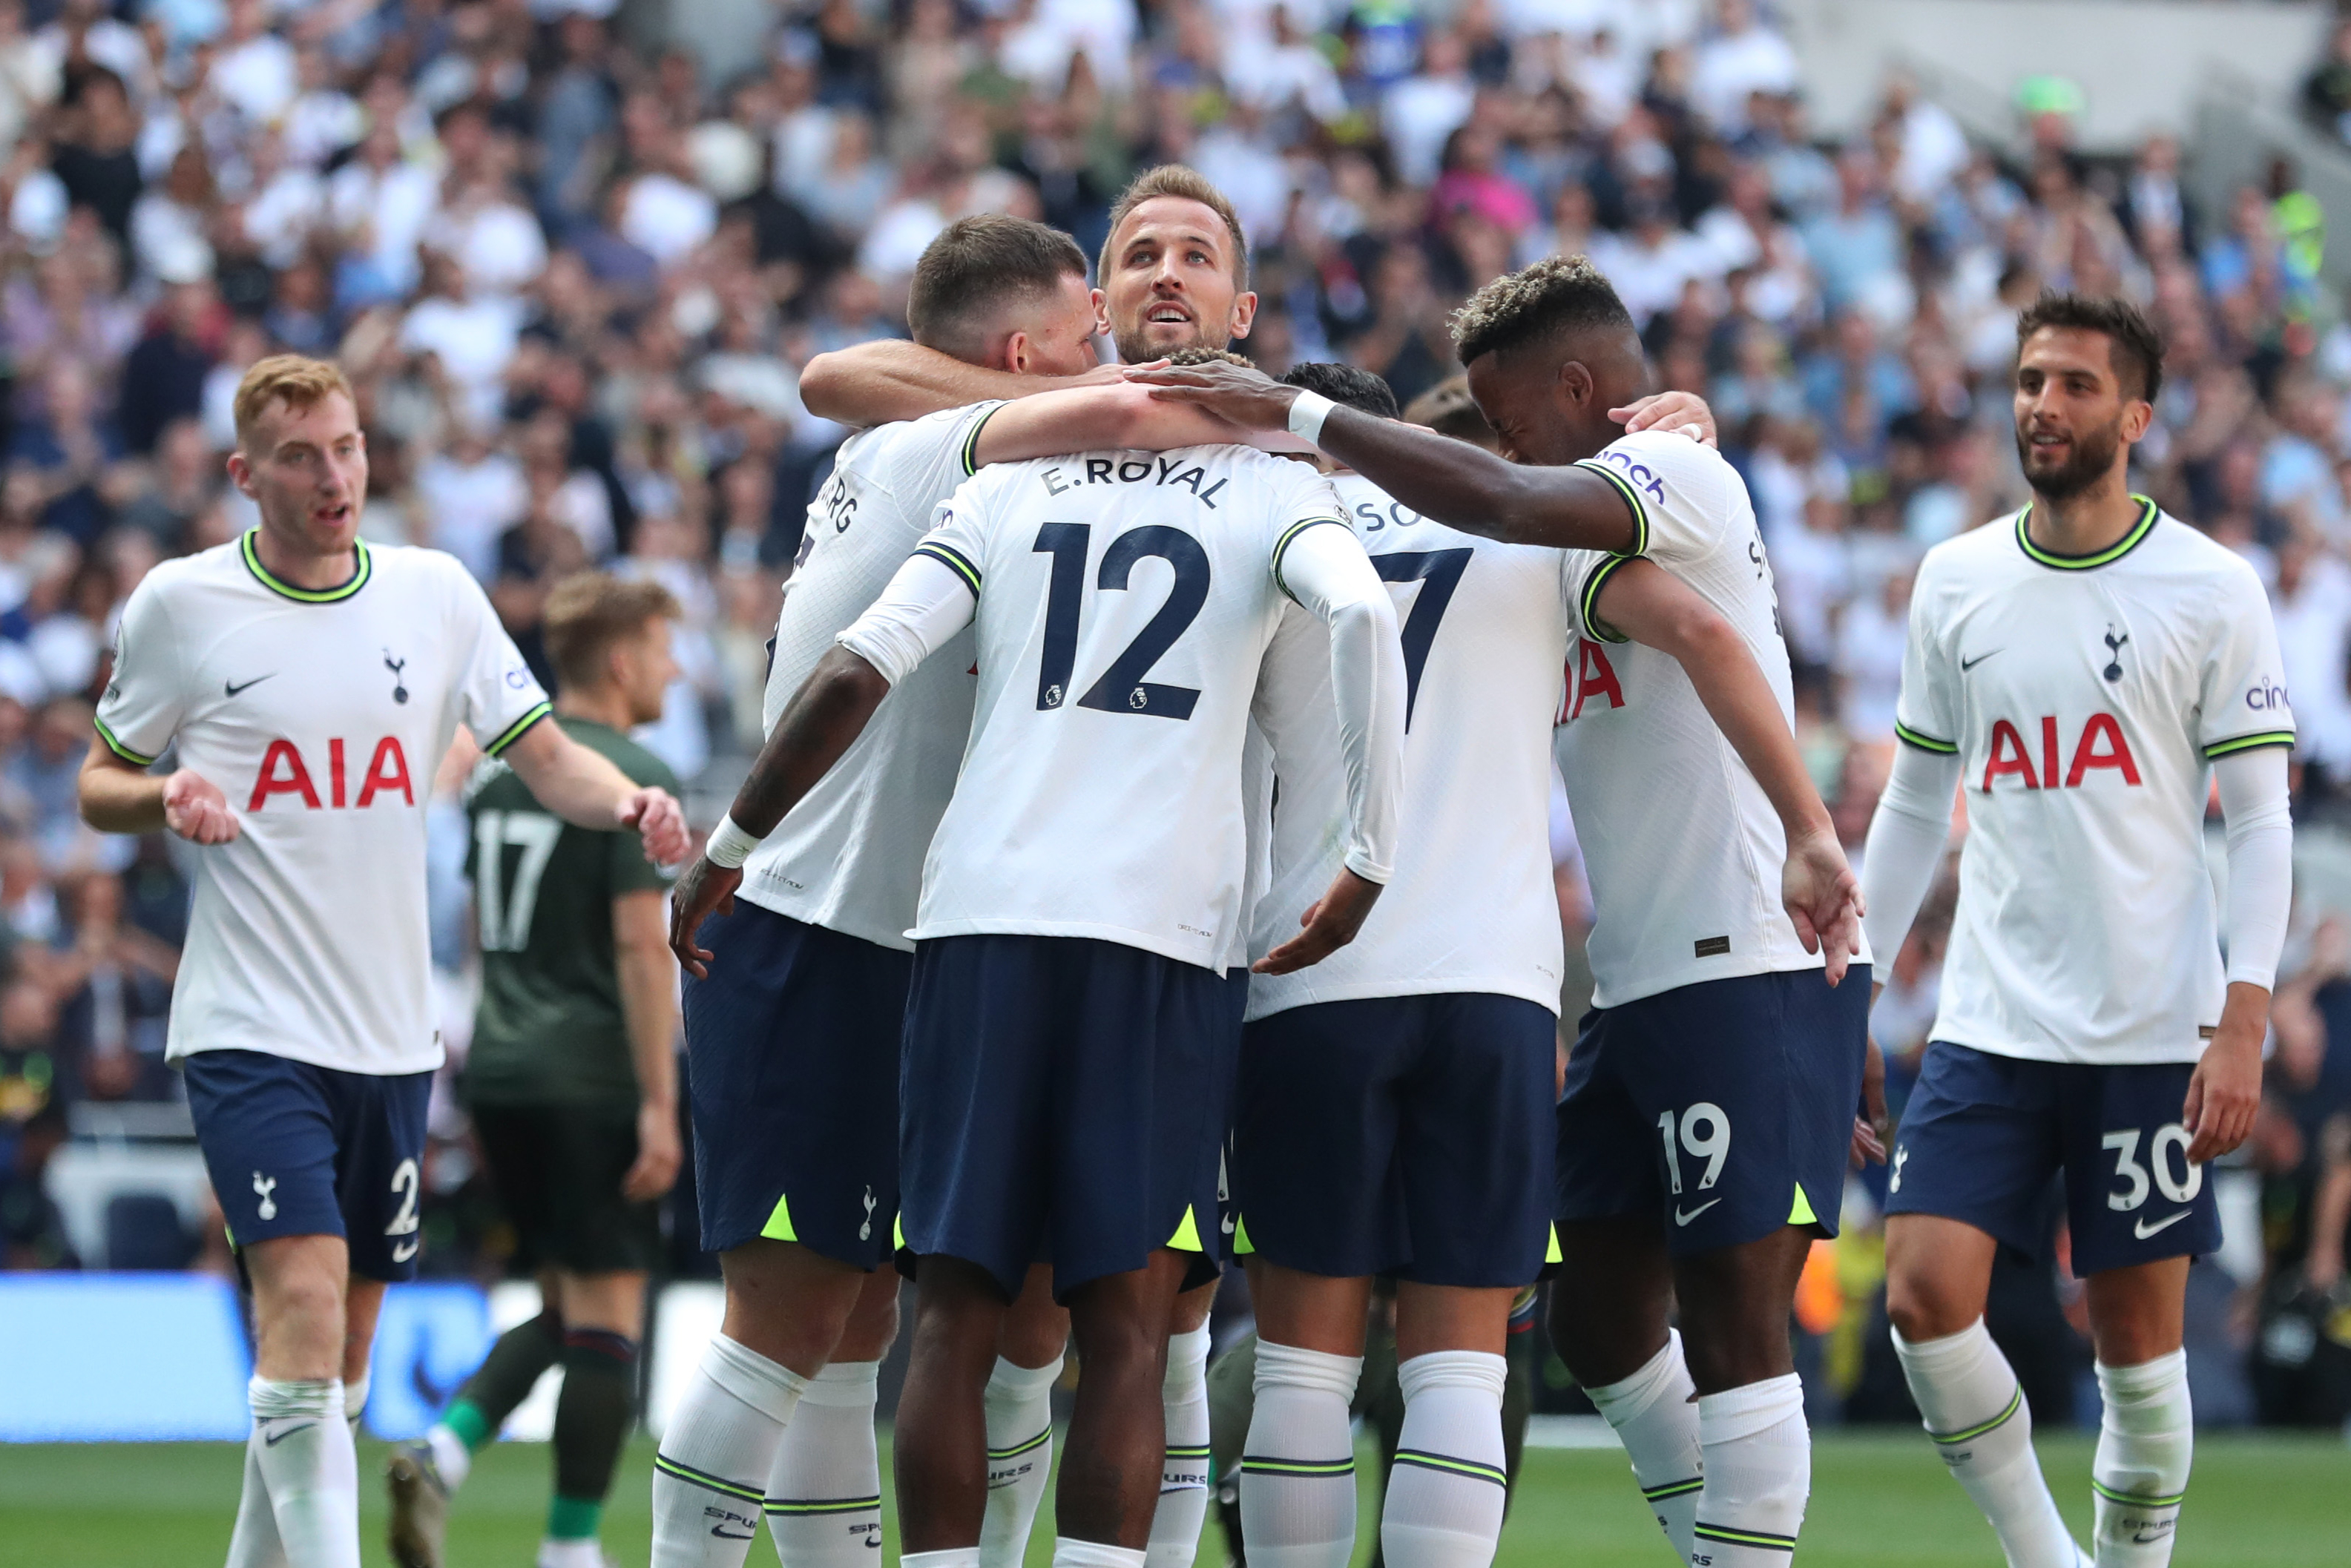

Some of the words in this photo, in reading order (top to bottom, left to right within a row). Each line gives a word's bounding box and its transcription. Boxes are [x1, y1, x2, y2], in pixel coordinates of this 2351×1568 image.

[1040, 457, 1229, 510] E.ROYAL
[1355, 502, 1422, 532] SO
[1032, 521, 1211, 721] 12
[1369, 547, 1474, 735] 7
[248, 736, 414, 812] AIA
[1982, 713, 2143, 794] AIA
[474, 808, 565, 952] 17
[1657, 1101, 1731, 1195] 19
[2102, 1122, 2203, 1212] 30
